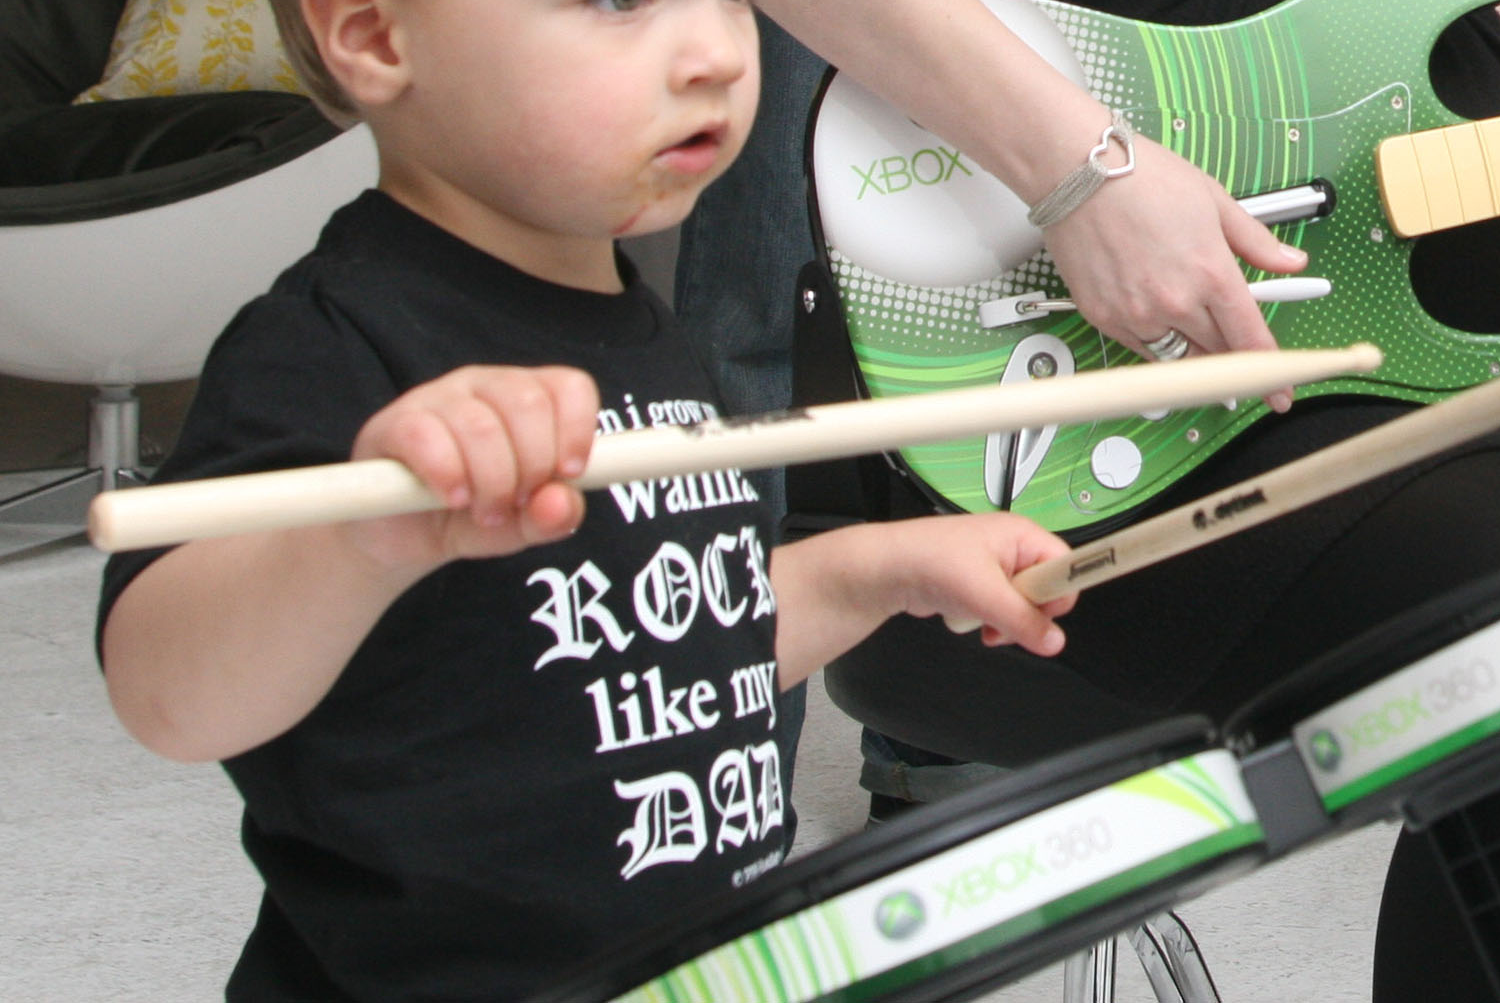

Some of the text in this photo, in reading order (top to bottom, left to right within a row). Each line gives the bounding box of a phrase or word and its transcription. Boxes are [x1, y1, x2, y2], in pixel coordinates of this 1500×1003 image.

[851, 147, 973, 200] XBOX
[624, 393, 645, 429] i
[526, 526, 777, 671] ROCK
[585, 660, 777, 753] like my
[1341, 656, 1497, 753] XBOX 360
[614, 740, 784, 881] DAD
[932, 816, 1115, 918] XBOX 360
